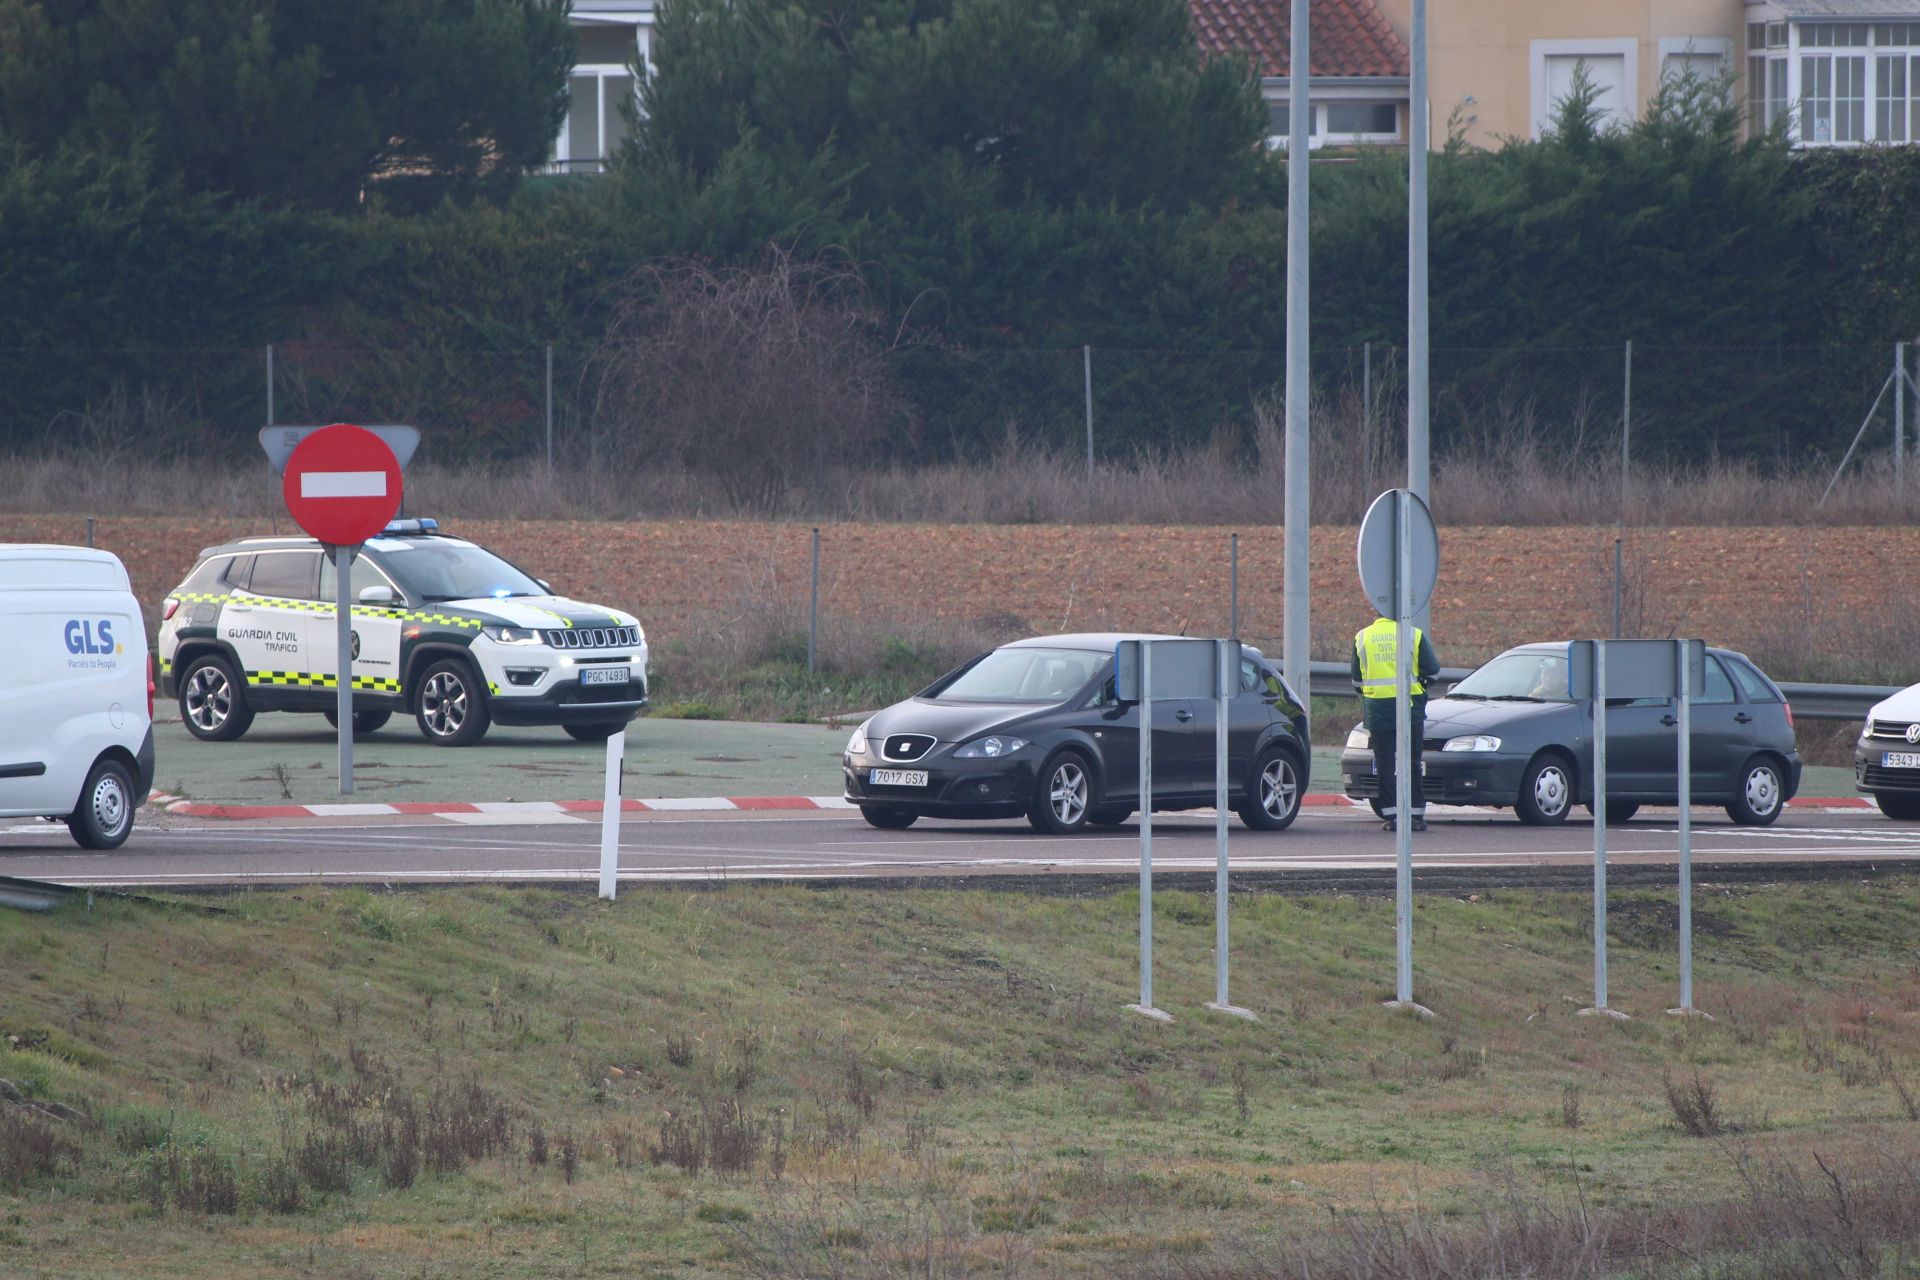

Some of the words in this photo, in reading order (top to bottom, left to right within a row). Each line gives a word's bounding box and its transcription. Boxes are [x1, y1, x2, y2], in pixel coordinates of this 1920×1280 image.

[228, 629, 272, 640] GUARDIA
[276, 631, 298, 642] CIVIL
[1378, 643, 1394, 652] CIVIL
[68, 659, 89, 668] Parcels
[97, 659, 117, 671] People
[587, 671, 604, 682] PGC
[1889, 754, 1913, 766] 5343
[877, 771, 902, 783] 7017
[905, 773, 925, 785] GSX
